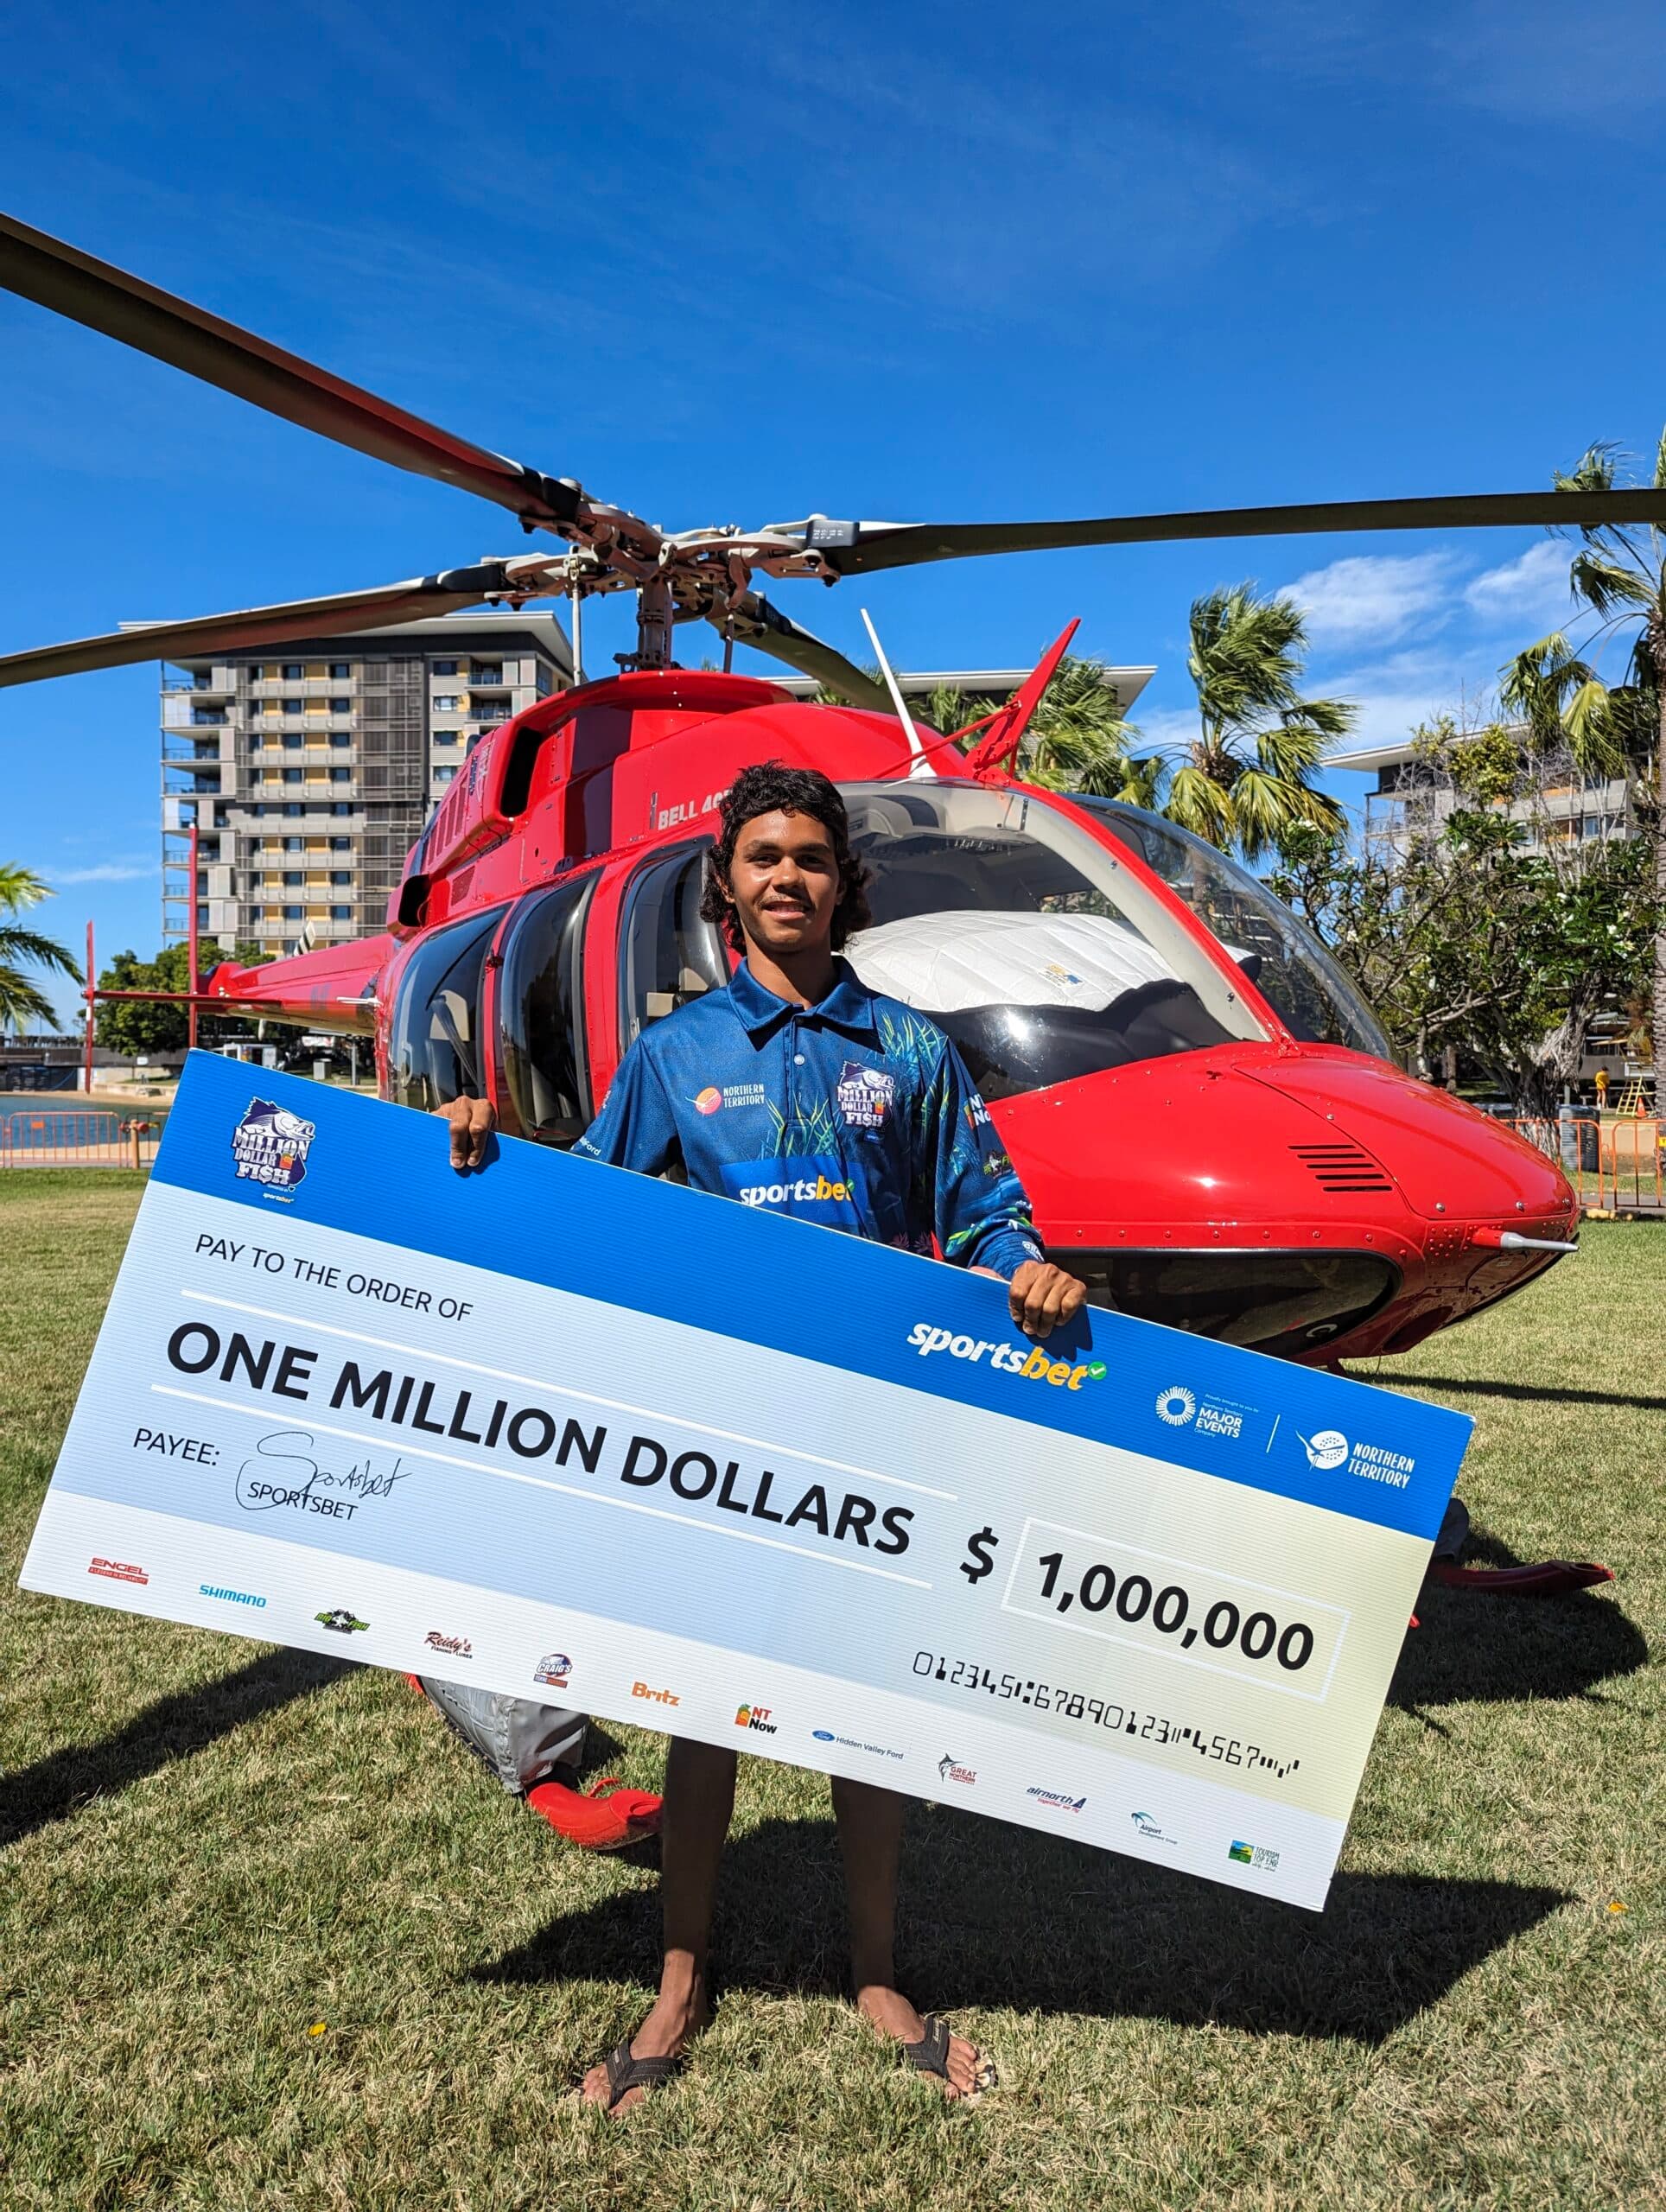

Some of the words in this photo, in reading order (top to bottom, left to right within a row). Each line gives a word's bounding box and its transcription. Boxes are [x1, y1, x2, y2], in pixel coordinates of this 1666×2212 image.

[658, 801, 698, 830] BELL
[702, 788, 733, 814] 40
[723, 1084, 765, 1096] NORTHERN
[836, 1085, 893, 1106] MILLION
[723, 1094, 765, 1109] TERRITORY
[841, 1101, 873, 1113] DOLLAR
[232, 1126, 311, 1160] MILLION
[233, 1147, 277, 1167] DOLLAR
[195, 1234, 245, 1262] PAY
[251, 1248, 284, 1274] TO
[293, 1258, 341, 1289] THE
[347, 1274, 432, 1313] ORDER
[438, 1297, 474, 1322] OF
[907, 1323, 1089, 1391] sportsbet
[1195, 1417, 1240, 1439] EVENTS
[1199, 1407, 1243, 1428] MAJOR
[133, 1428, 220, 1466] PAYEE:
[167, 1321, 319, 1401] ONE
[329, 1361, 607, 1474] MILLION
[620, 1435, 915, 1555] DOLLARS
[1352, 1442, 1415, 1473] NORTHERN
[1347, 1458, 1411, 1490] TERRITORY
[247, 1481, 359, 1521] SPORTSBET
[92, 1557, 149, 1577] ENGEL
[199, 1585, 267, 1608] SHIMANO
[959, 1526, 1000, 1585] $
[1038, 1552, 1314, 1671] 1,000,000
[424, 1631, 472, 1653] Reidy's
[632, 1681, 681, 1707] Britz
[752, 1707, 773, 1721] NT
[748, 1719, 778, 1734] Now
[836, 1736, 862, 1750] Hidden
[863, 1743, 887, 1756] Valley
[887, 1749, 904, 1759] Ford
[951, 1766, 977, 1778] GREAT
[1027, 1787, 1073, 1805] airnorth
[1140, 1824, 1161, 1835] Airport
